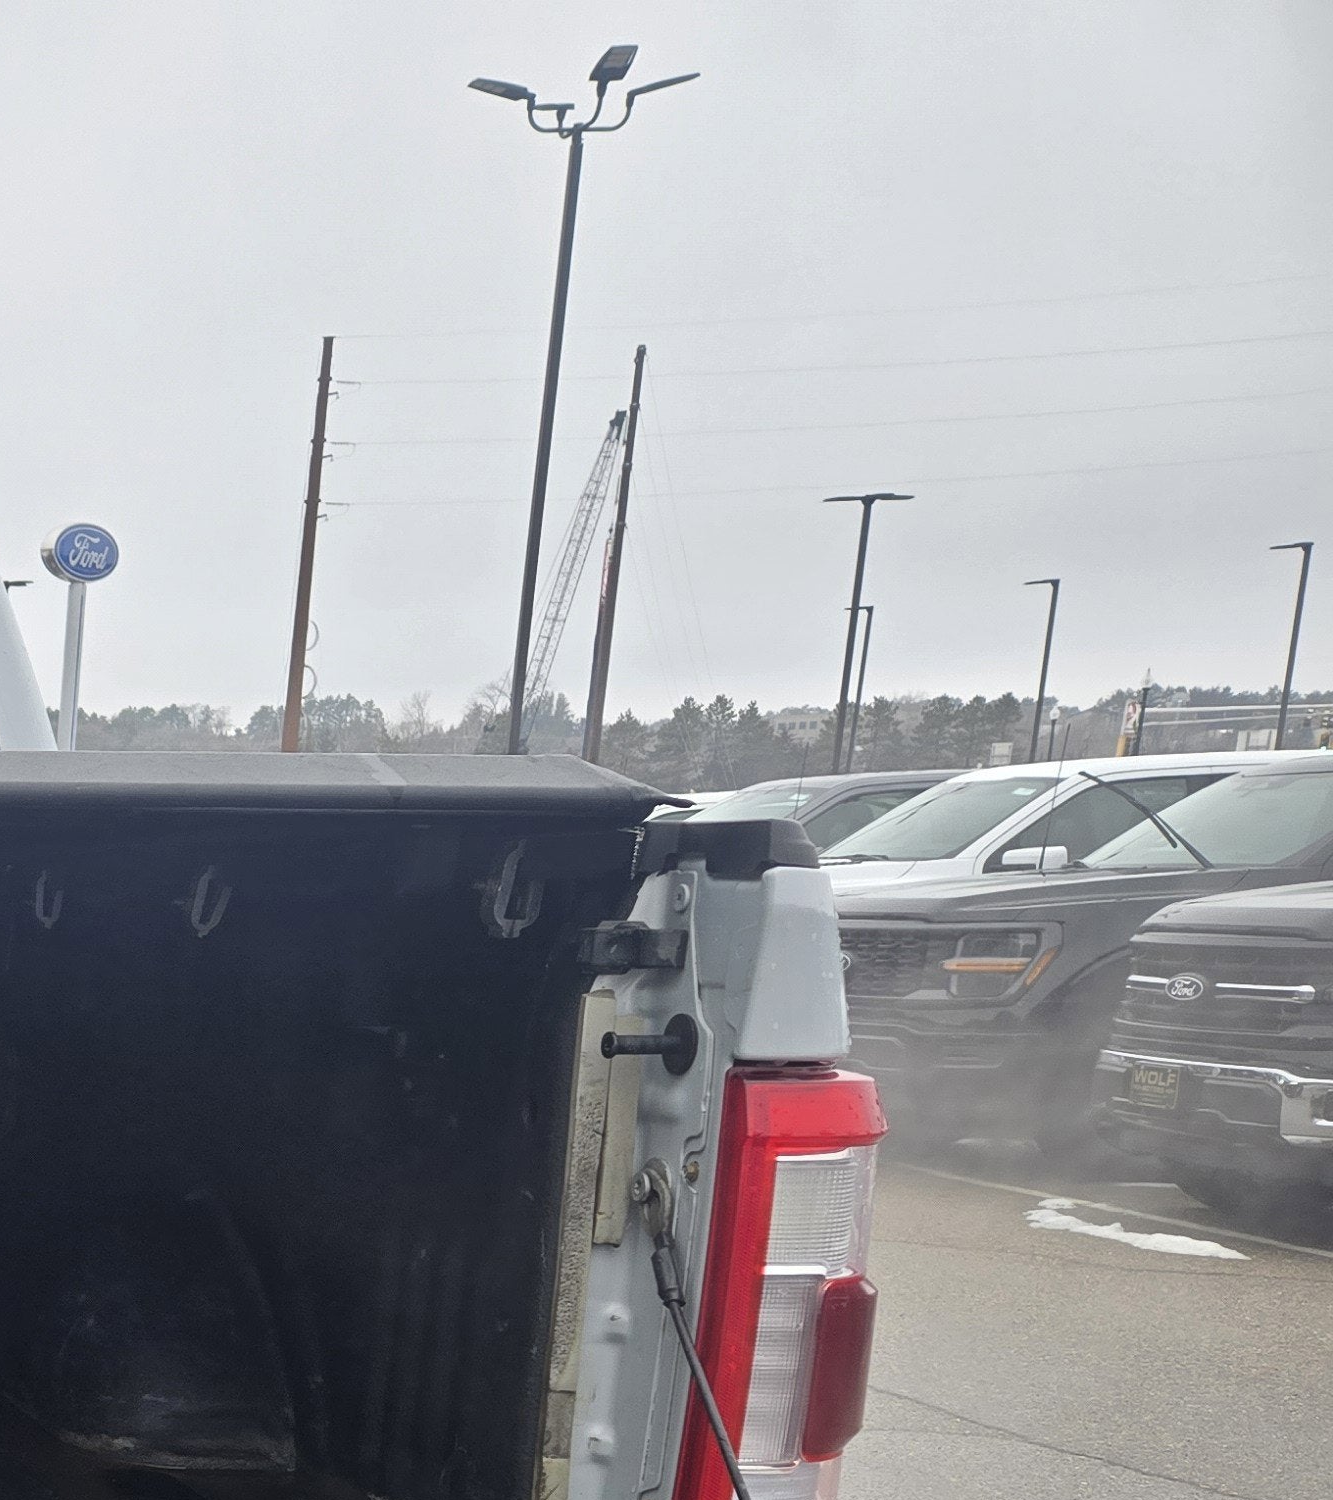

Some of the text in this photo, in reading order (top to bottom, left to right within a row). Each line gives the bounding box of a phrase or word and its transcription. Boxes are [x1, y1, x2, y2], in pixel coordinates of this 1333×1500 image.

[69, 533, 109, 570] Ford
[1171, 979, 1196, 997] Ford
[1134, 1070, 1176, 1086] WOLF
